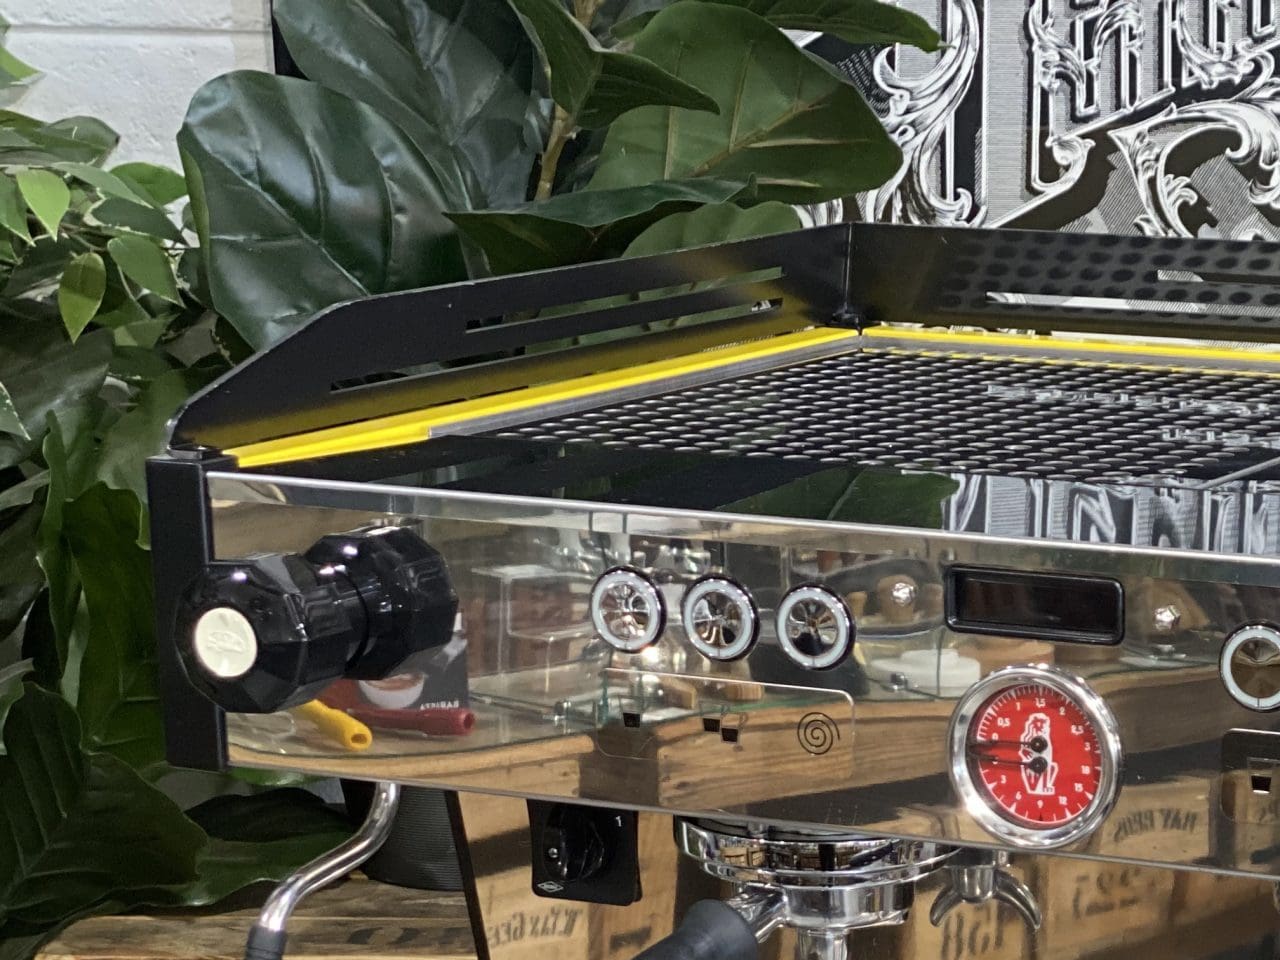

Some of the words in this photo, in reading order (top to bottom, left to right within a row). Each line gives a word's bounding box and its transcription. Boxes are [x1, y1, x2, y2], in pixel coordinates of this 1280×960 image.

[997, 717, 1011, 728] 0,5
[1074, 783, 1084, 793] 15
[1058, 796, 1068, 806] 12
